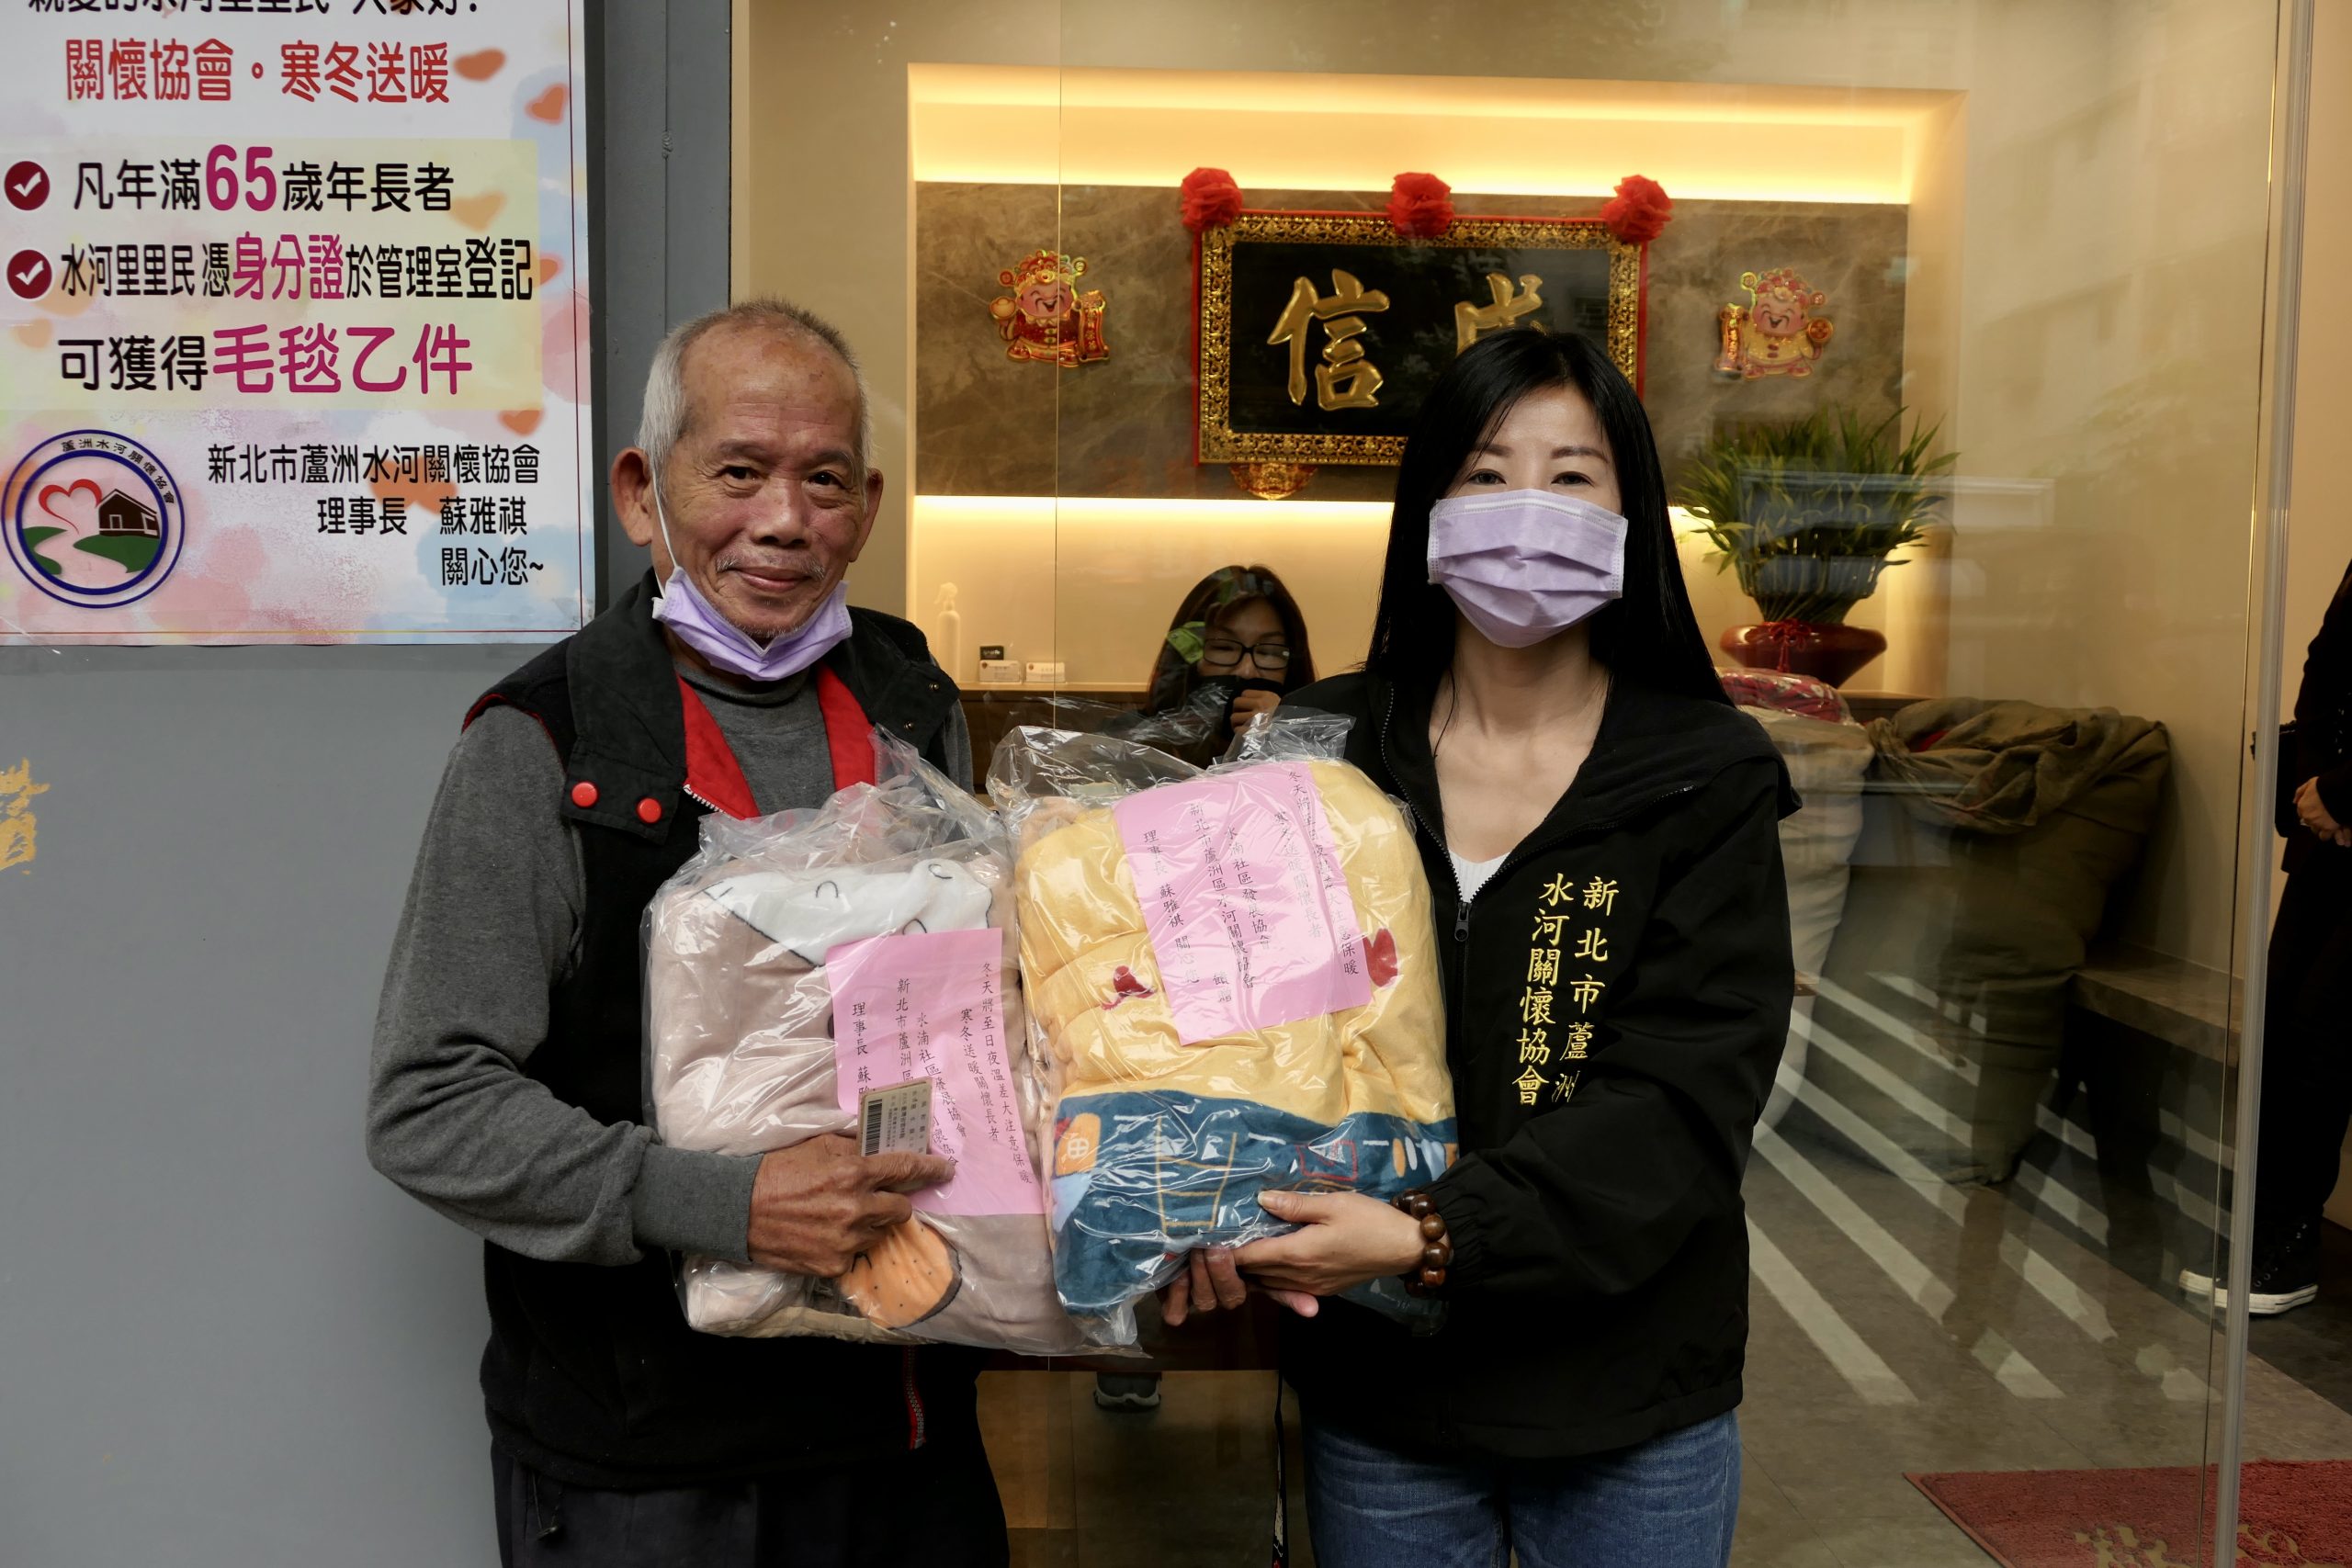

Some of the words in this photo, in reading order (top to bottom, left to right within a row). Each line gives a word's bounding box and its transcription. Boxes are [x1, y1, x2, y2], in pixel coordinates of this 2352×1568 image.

[73, 143, 455, 213] 凡年滿65歲年長者
[60, 231, 533, 301] 水河里里民憑身分證於管理室登記
[57, 323, 474, 396] 可獲得毛毯乙件
[1267, 268, 1391, 412] 信
[61, 438, 175, 504] 蘆洲水河關懷協會
[207, 443, 541, 486] 新北市蘆洲水河關懷協會
[316, 497, 409, 536] 理事長
[439, 497, 528, 537] 蘇雅祺
[1511, 872, 1576, 1106] 水河關懷協會
[1551, 875, 1620, 1103] 新北市蘆洲
[852, 1001, 869, 1056] 理事長
[960, 1008, 1001, 1143] 寒冬送暖關懷長者
[980, 961, 1033, 1185] 冬天將至日夜溫差大注意保暖
